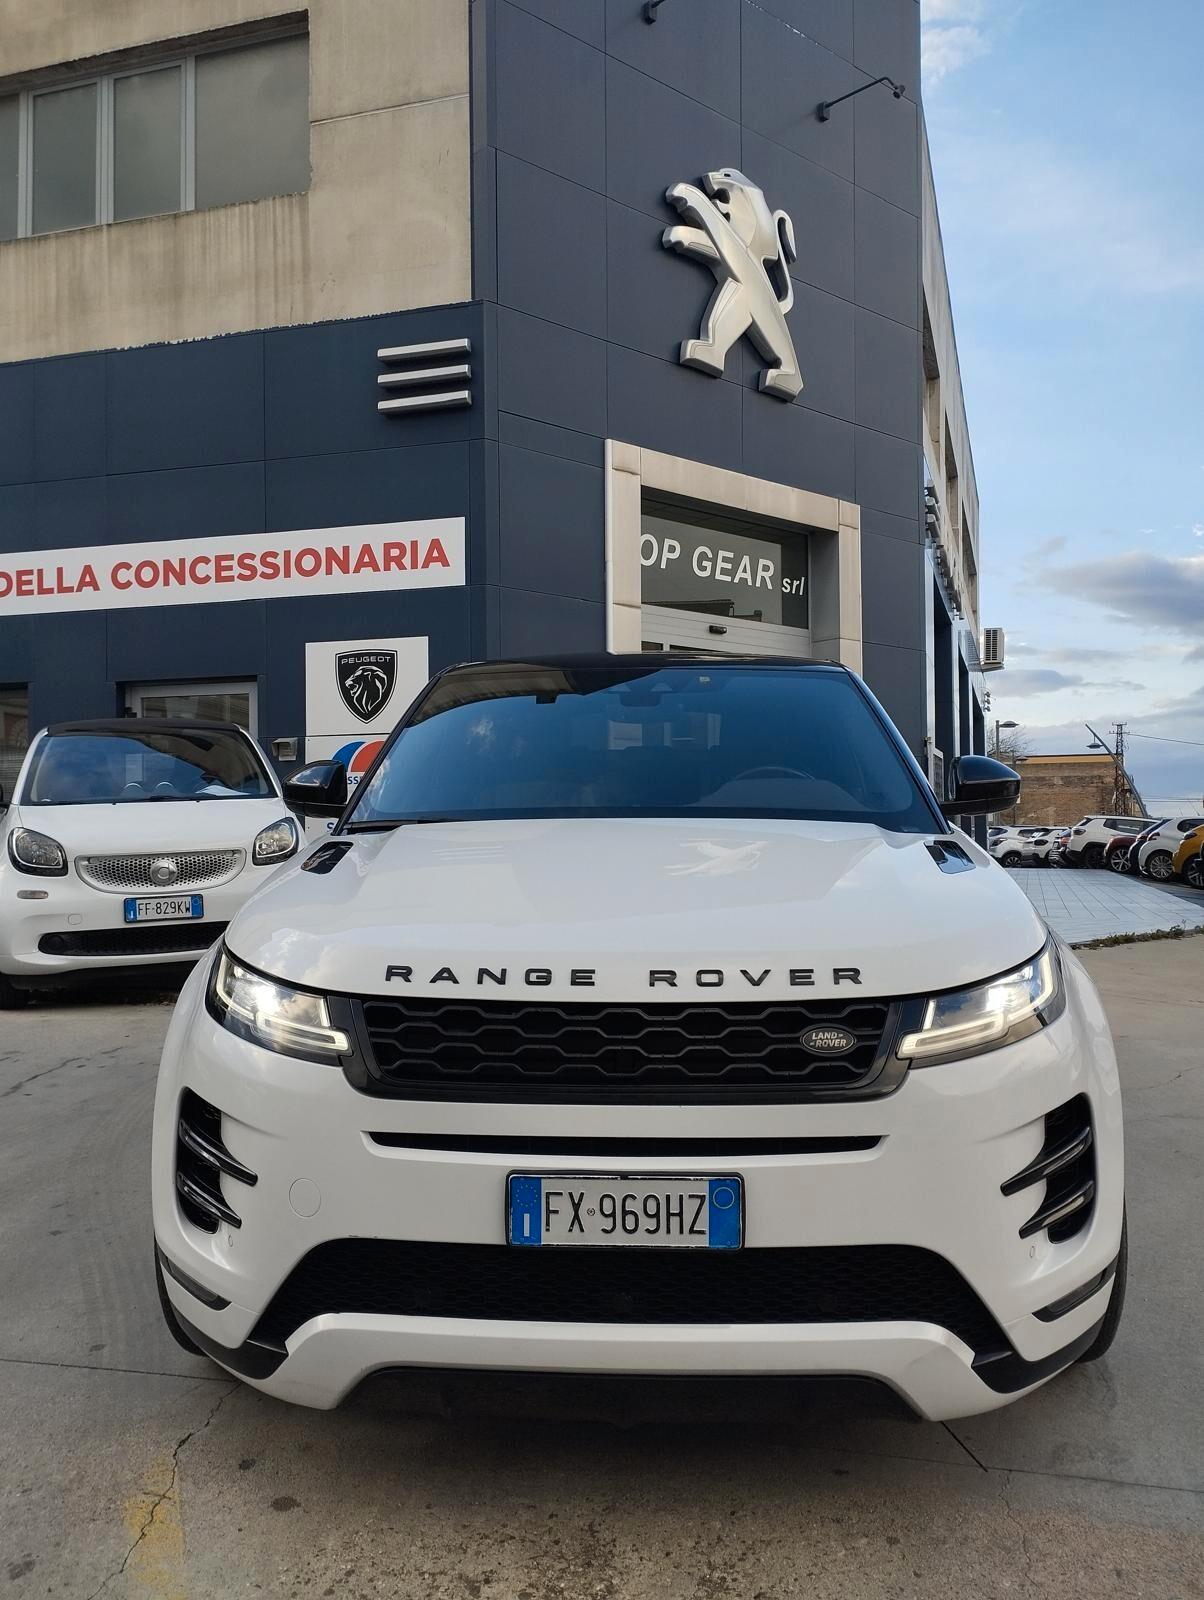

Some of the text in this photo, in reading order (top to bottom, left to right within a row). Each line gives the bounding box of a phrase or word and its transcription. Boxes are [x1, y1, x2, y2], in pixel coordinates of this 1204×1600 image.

[110, 538, 451, 590] CONCESSIONARIA
[692, 545, 775, 590] GEAR
[781, 576, 805, 596] srl
[341, 656, 391, 664] PEUGEOT
[385, 965, 864, 988] RANGE ROVER
[812, 1031, 838, 1040] LAND
[815, 1039, 847, 1048] ROVER
[599, 1193, 707, 1235] 969HZ
